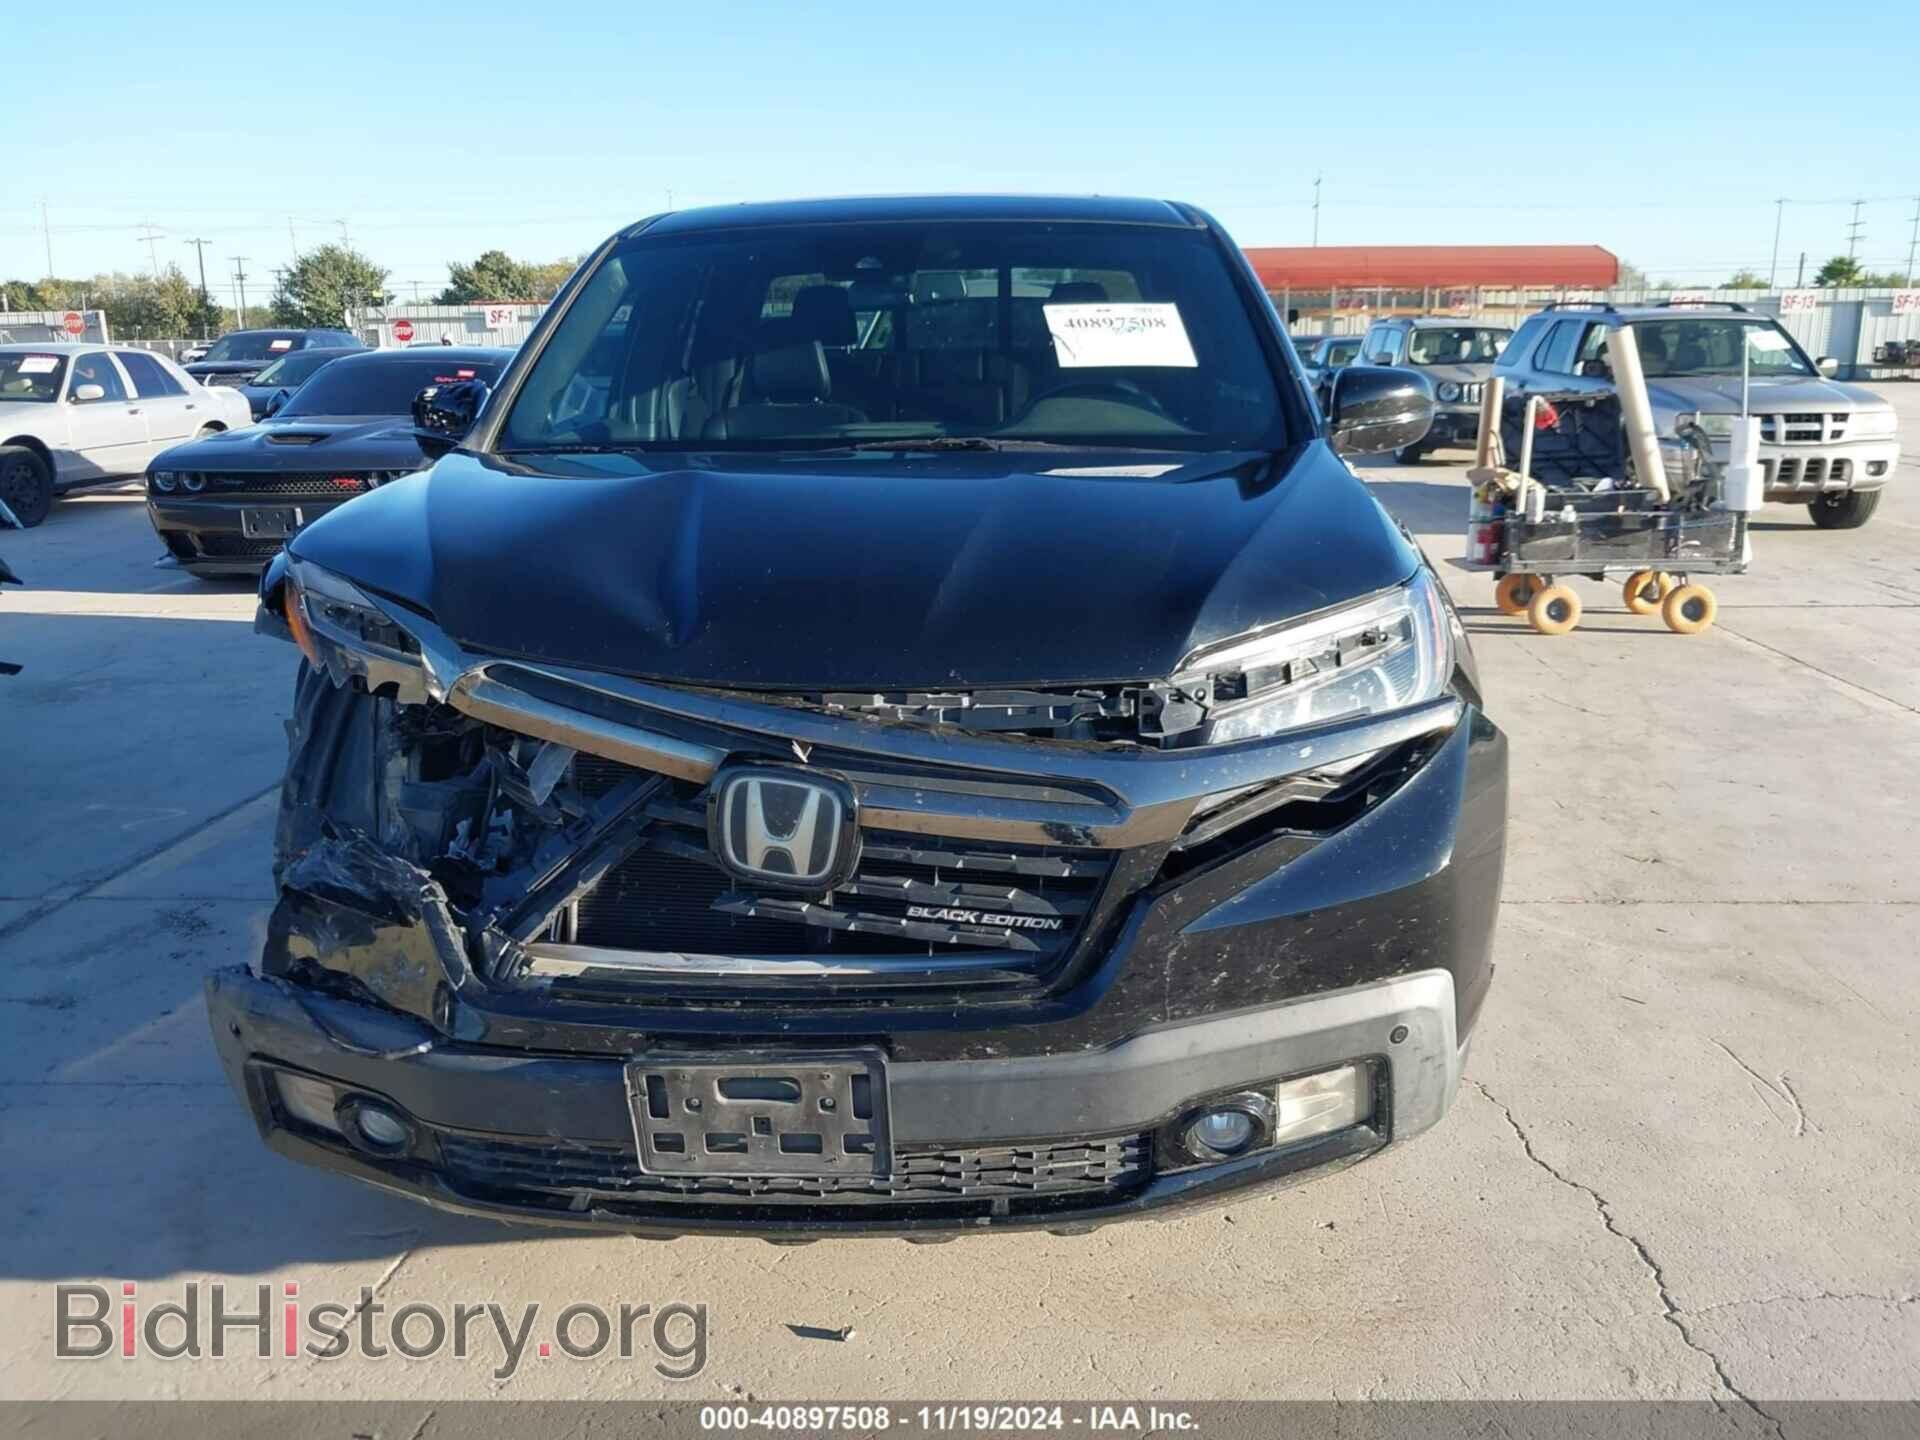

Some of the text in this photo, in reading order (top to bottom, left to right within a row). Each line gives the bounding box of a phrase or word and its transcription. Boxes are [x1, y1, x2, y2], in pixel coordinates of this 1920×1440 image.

[1782, 295, 1815, 310] SF-13
[490, 310, 513, 324] SF-1
[1064, 317, 1167, 329] 40897508
[394, 325, 414, 336] STOP
[906, 906, 1062, 930] BLACK EDITION
